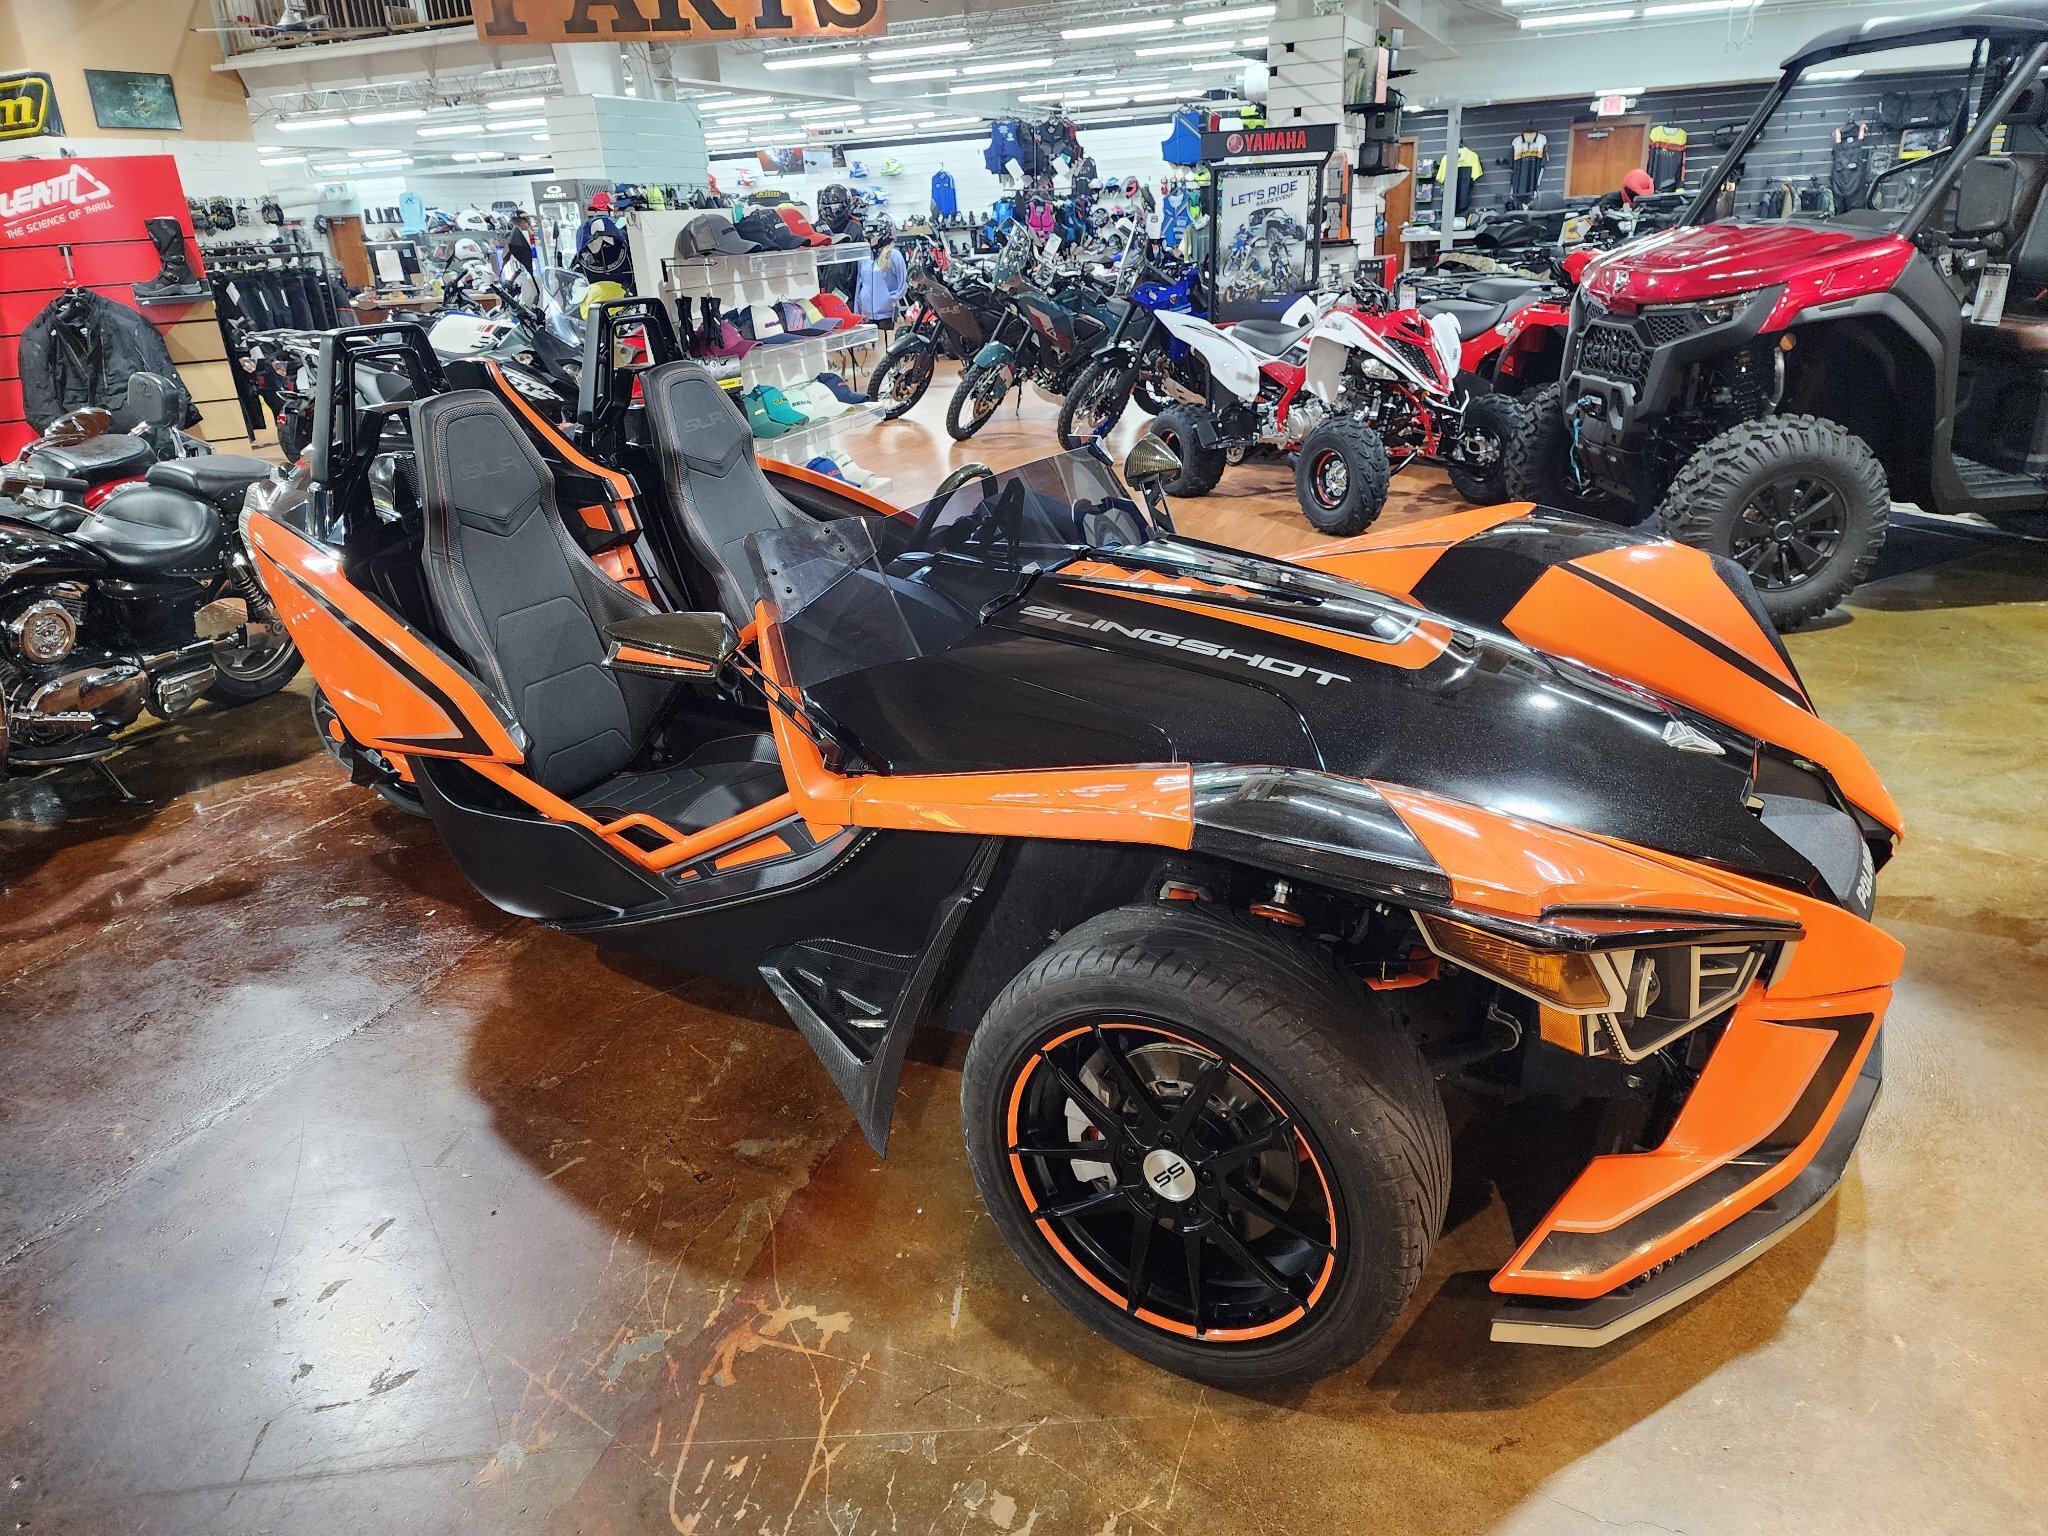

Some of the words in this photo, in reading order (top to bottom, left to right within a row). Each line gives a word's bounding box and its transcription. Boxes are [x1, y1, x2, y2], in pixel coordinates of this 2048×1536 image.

[1245, 131, 1307, 151] YAMAHA
[1231, 189, 1265, 207] LET'S
[1269, 180, 1298, 198] RIDE
[1256, 197, 1275, 206] SALES
[1275, 192, 1294, 202] EVENT
[6, 226, 24, 239] THE
[26, 213, 67, 234] SCIENCE
[69, 208, 81, 221] OF
[84, 200, 114, 214] THRILL
[1019, 605, 1352, 686] SLINGSHOT
[1153, 1161, 1186, 1188] SS
